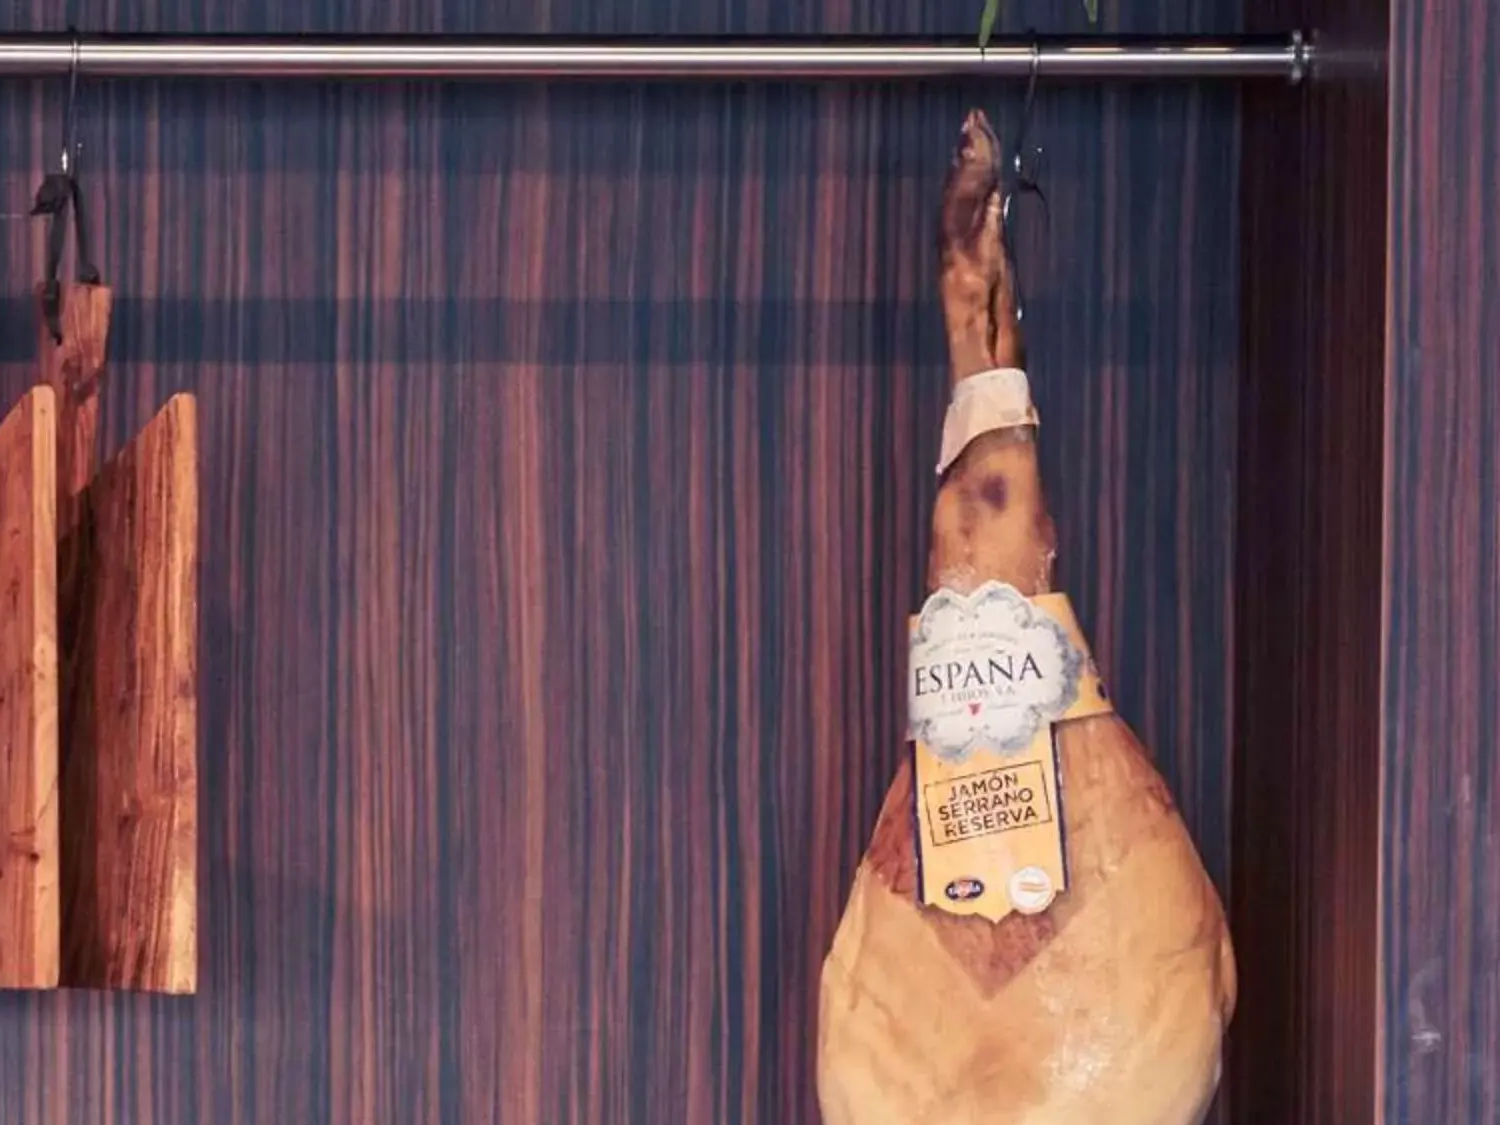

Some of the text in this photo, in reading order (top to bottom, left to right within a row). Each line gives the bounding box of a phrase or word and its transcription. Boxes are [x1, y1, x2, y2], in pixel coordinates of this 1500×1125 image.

[915, 649, 1043, 696] ESPAÑA
[948, 770, 1019, 802] JAMÓN
[938, 787, 1034, 821] SERRANO
[944, 805, 1037, 838] RESERVA
